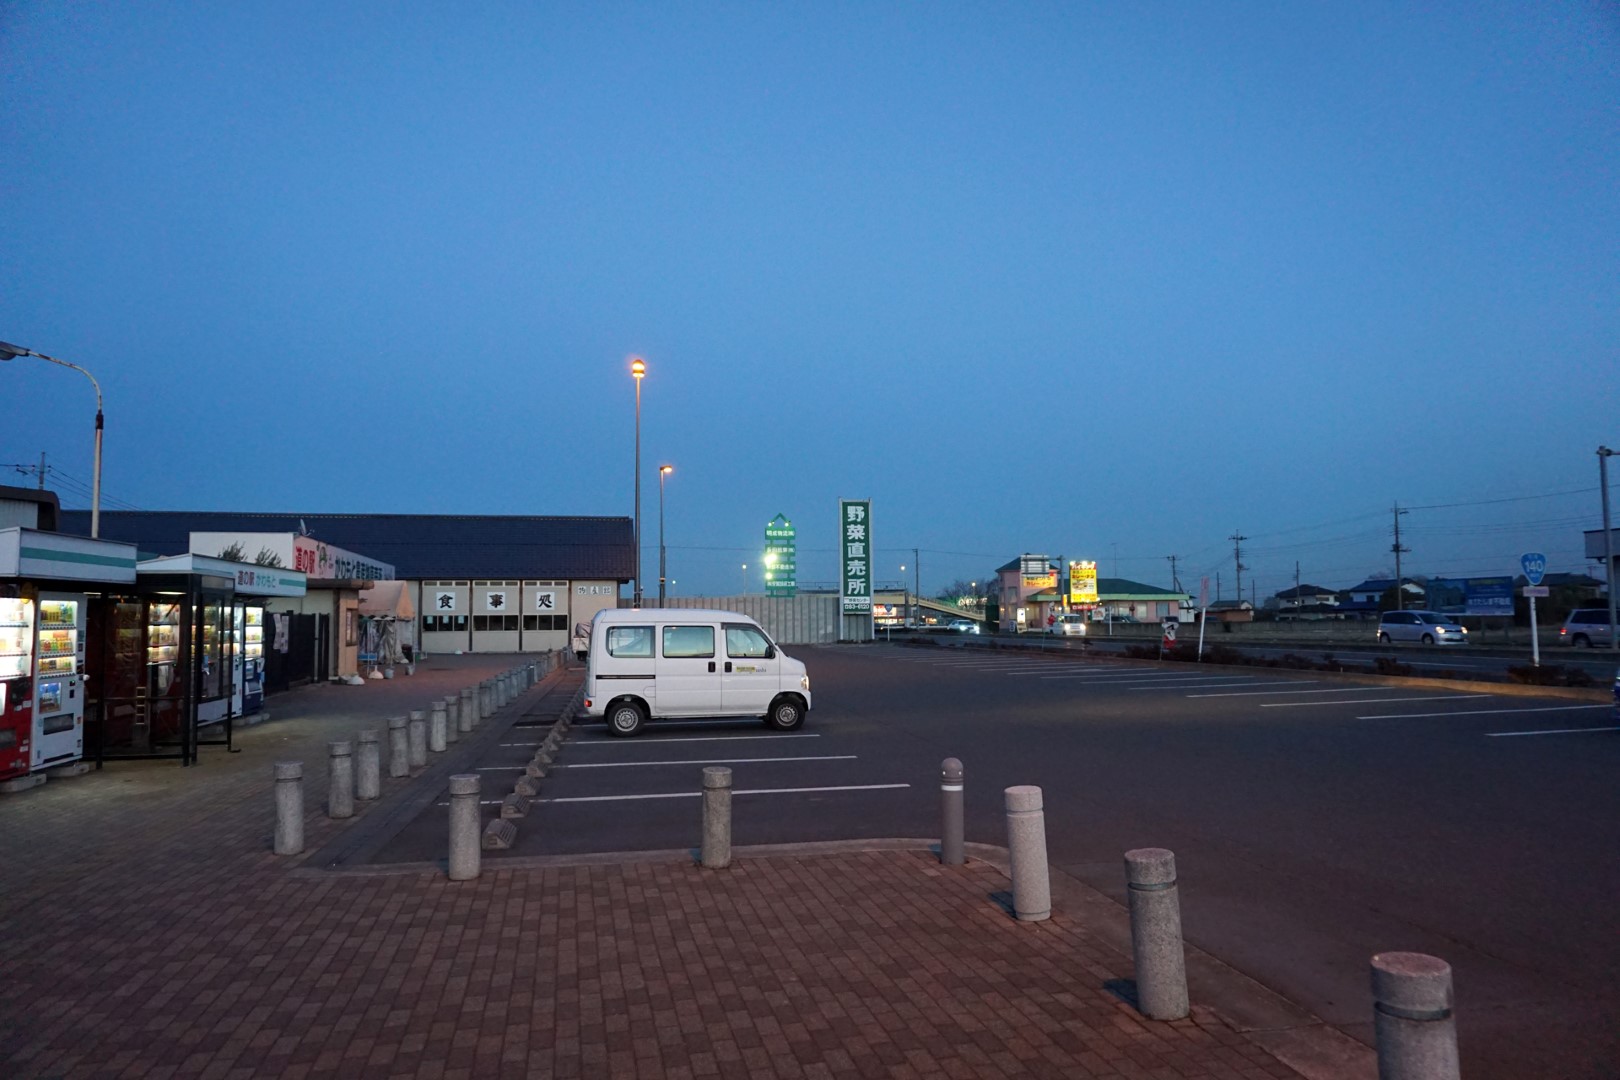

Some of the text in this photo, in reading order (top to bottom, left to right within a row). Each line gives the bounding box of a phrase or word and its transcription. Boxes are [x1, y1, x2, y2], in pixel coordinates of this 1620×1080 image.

[847, 505, 866, 595] 野菜直売所
[295, 546, 315, 574] 道の駅
[1525, 560, 1544, 572] 140
[238, 570, 277, 588] 道の駅 かわもと
[438, 594, 553, 608] 食事処
